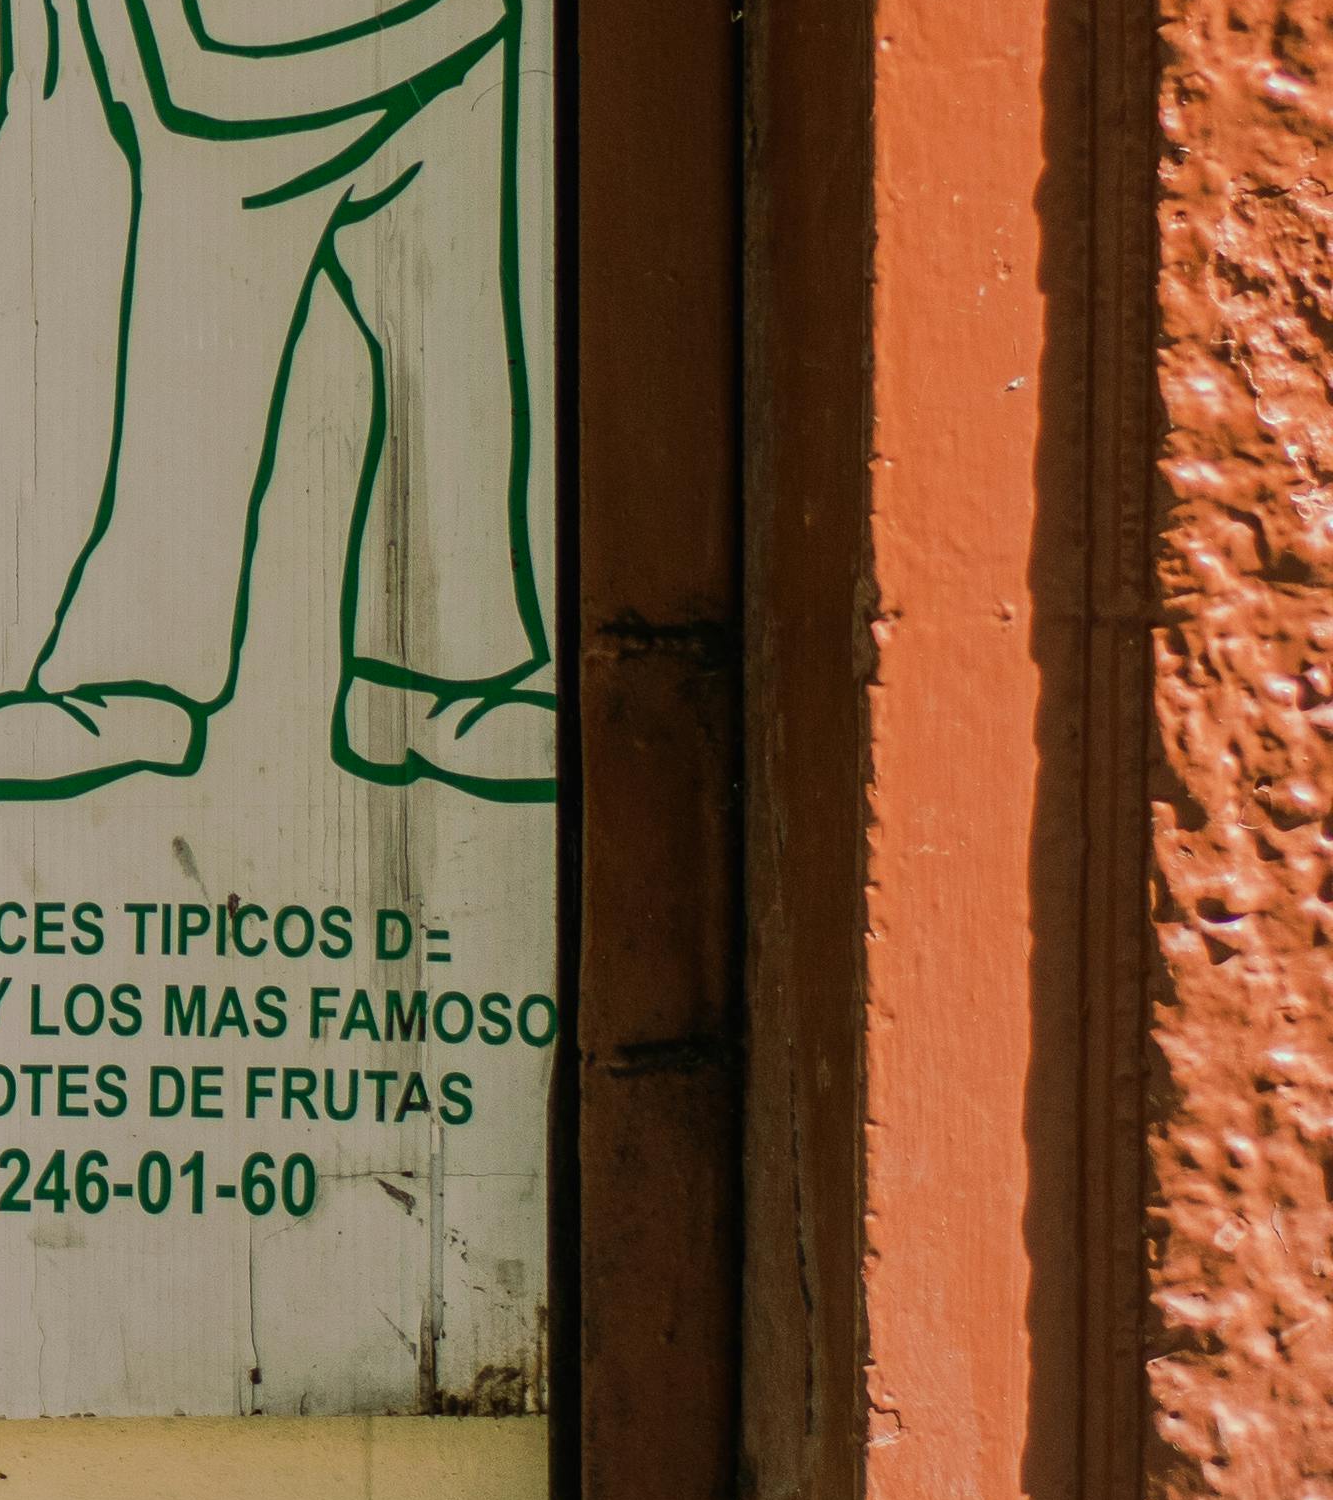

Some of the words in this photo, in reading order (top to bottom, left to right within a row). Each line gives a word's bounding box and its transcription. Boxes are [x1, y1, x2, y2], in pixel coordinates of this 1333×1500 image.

[124, 901, 354, 961] TIPICOS
[31, 983, 144, 1039] LOS
[163, 986, 289, 1040] MAS
[148, 1065, 225, 1120] DE
[245, 1068, 475, 1126] FRUTAS
